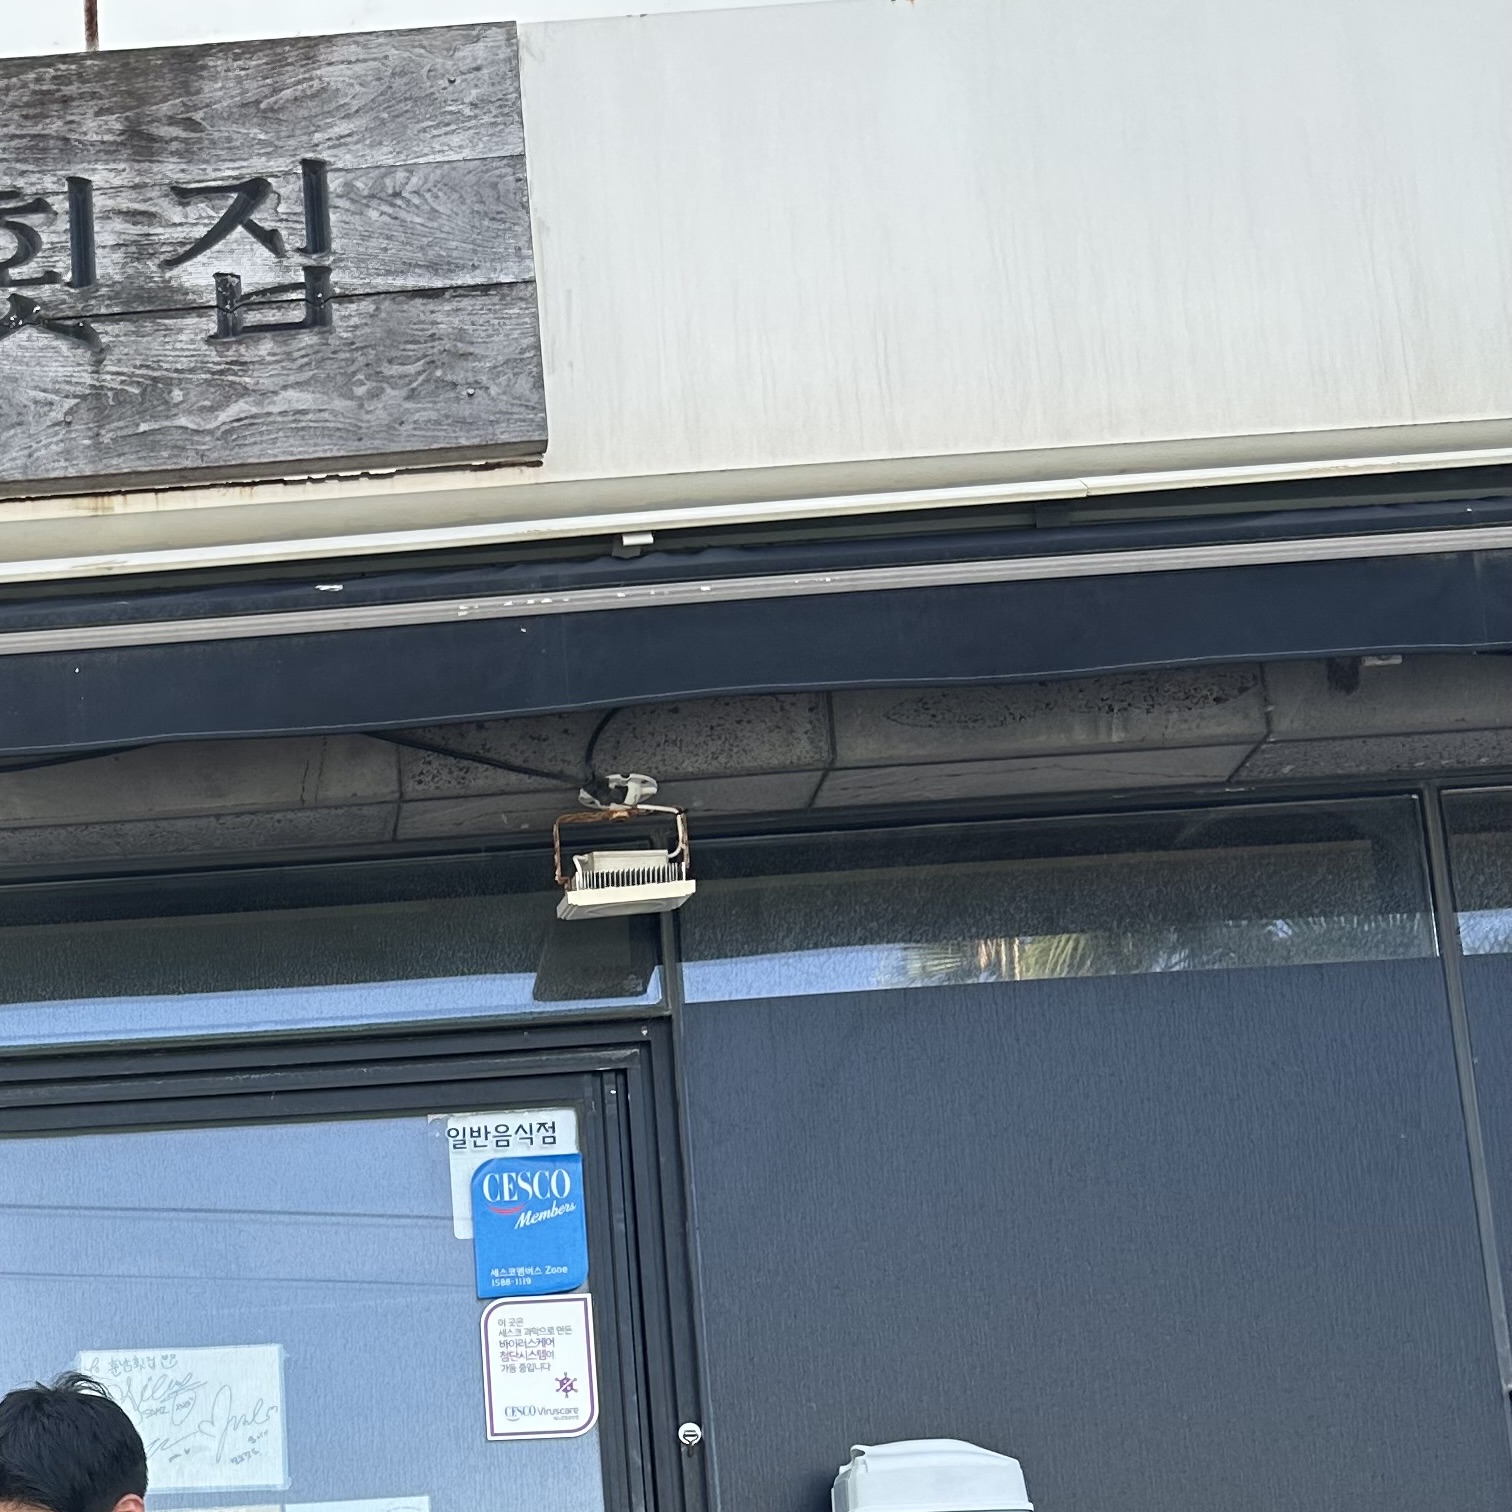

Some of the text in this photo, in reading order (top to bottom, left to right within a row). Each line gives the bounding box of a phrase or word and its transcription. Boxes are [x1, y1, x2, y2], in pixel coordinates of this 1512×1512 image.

[446, 1121, 557, 1150] 일반음식점
[483, 1168, 571, 1202] CESCO
[514, 1200, 577, 1230] Members
[544, 1265, 568, 1275] Zone
[491, 1276, 532, 1287] 1588-1119
[497, 1317, 524, 1328] 이 곳은
[498, 1336, 555, 1349] 바이러스케어
[504, 1404, 536, 1417] CESCO
